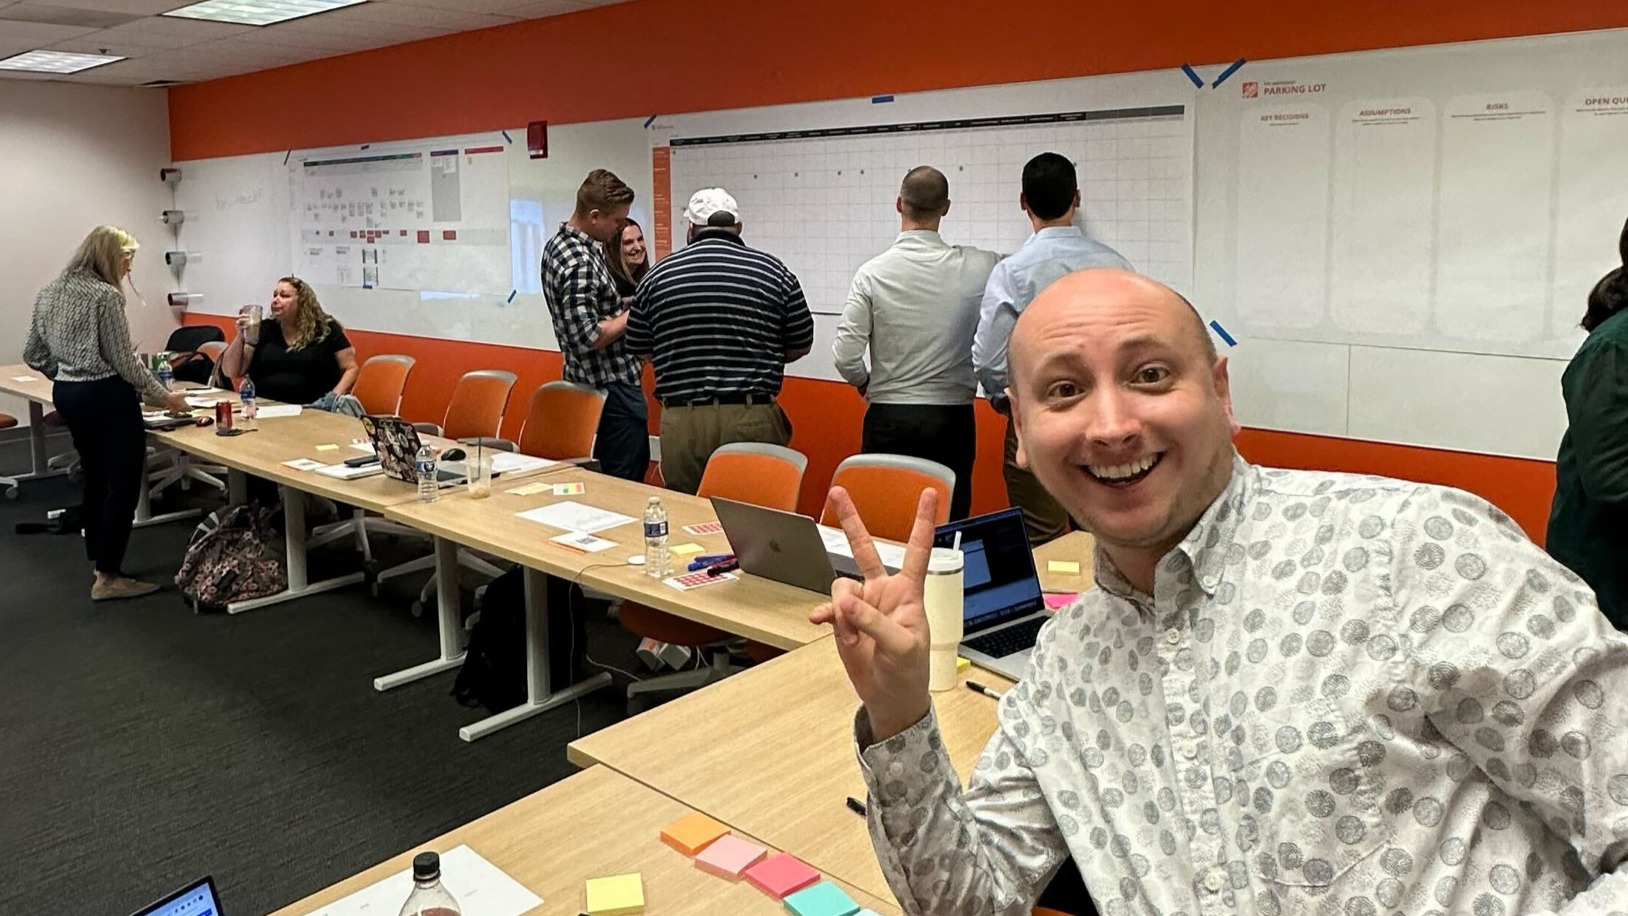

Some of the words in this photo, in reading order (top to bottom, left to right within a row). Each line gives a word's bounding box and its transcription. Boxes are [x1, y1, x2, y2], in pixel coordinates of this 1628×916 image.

[1263, 85, 1306, 95] PARKING
[1308, 84, 1327, 92] LOT
[1359, 108, 1411, 116] ASSUMPTIONS
